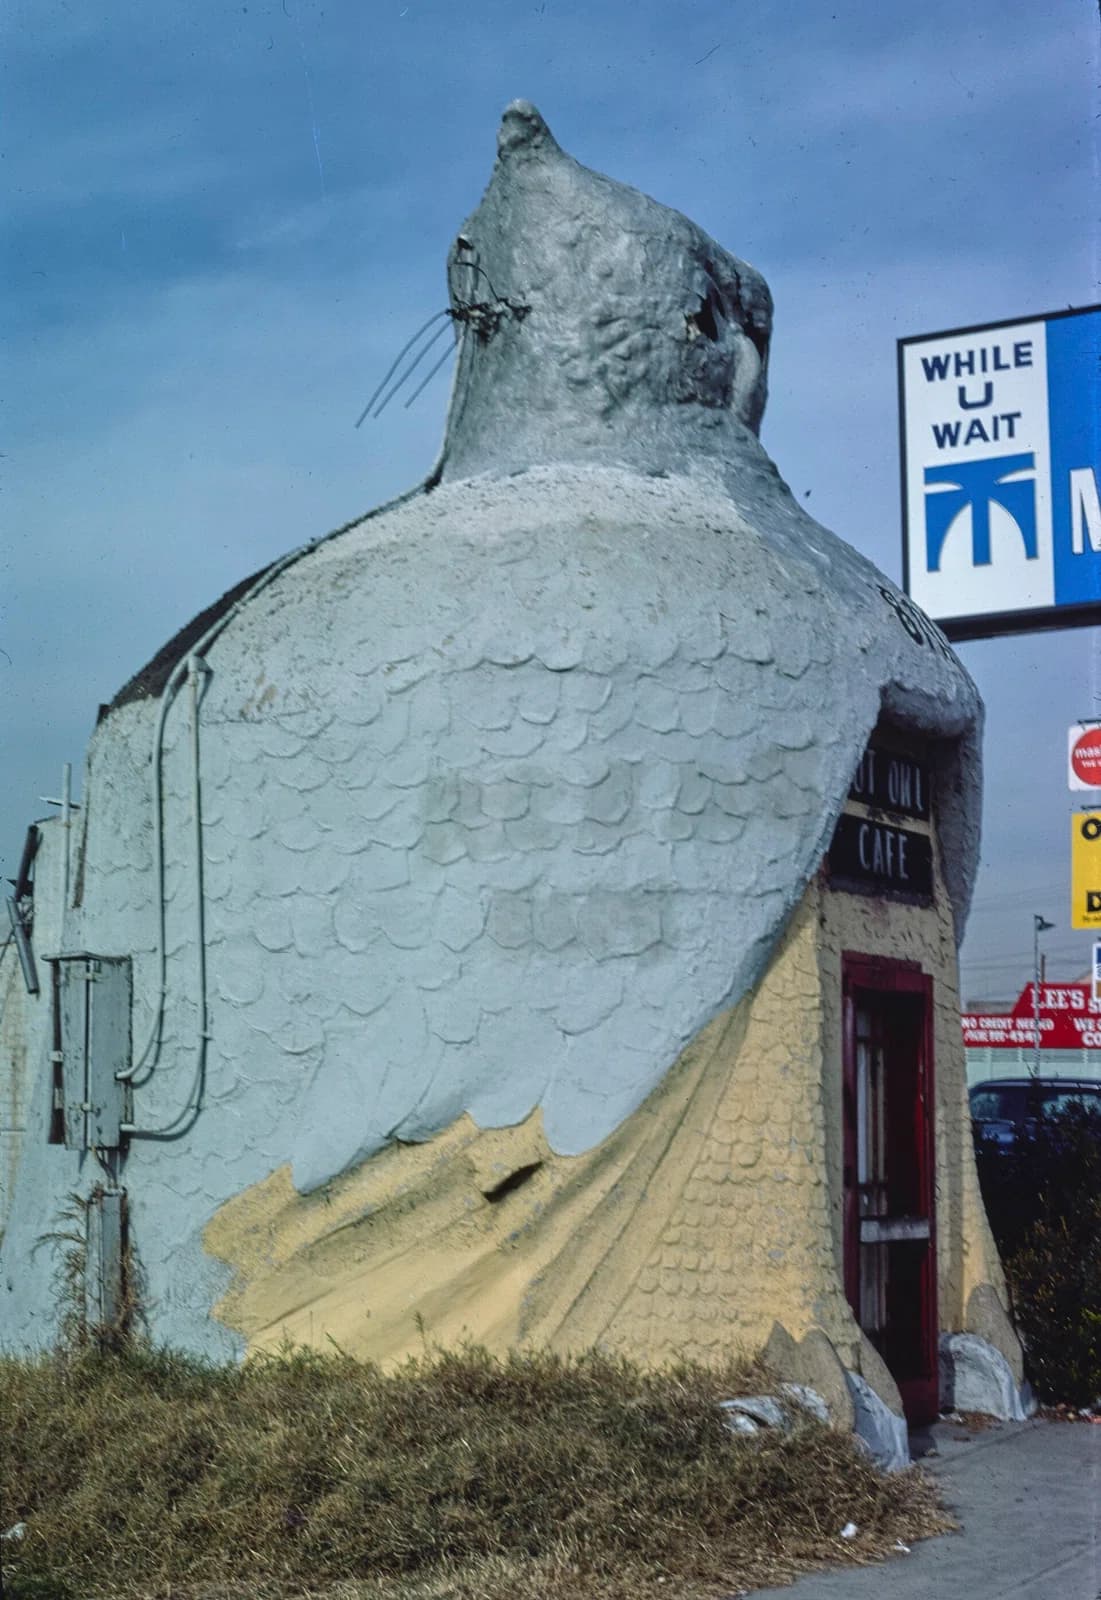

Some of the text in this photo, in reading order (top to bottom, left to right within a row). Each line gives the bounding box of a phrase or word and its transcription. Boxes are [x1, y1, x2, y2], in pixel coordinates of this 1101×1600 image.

[920, 340, 1033, 382] WHILE
[957, 381, 993, 411] U
[931, 411, 1022, 449] WAIT
[858, 823, 909, 880] CAFE
[1030, 988, 1085, 1009] LEE'S
[961, 1017, 977, 1029] NO
[979, 1017, 1013, 1030] CREDIT
